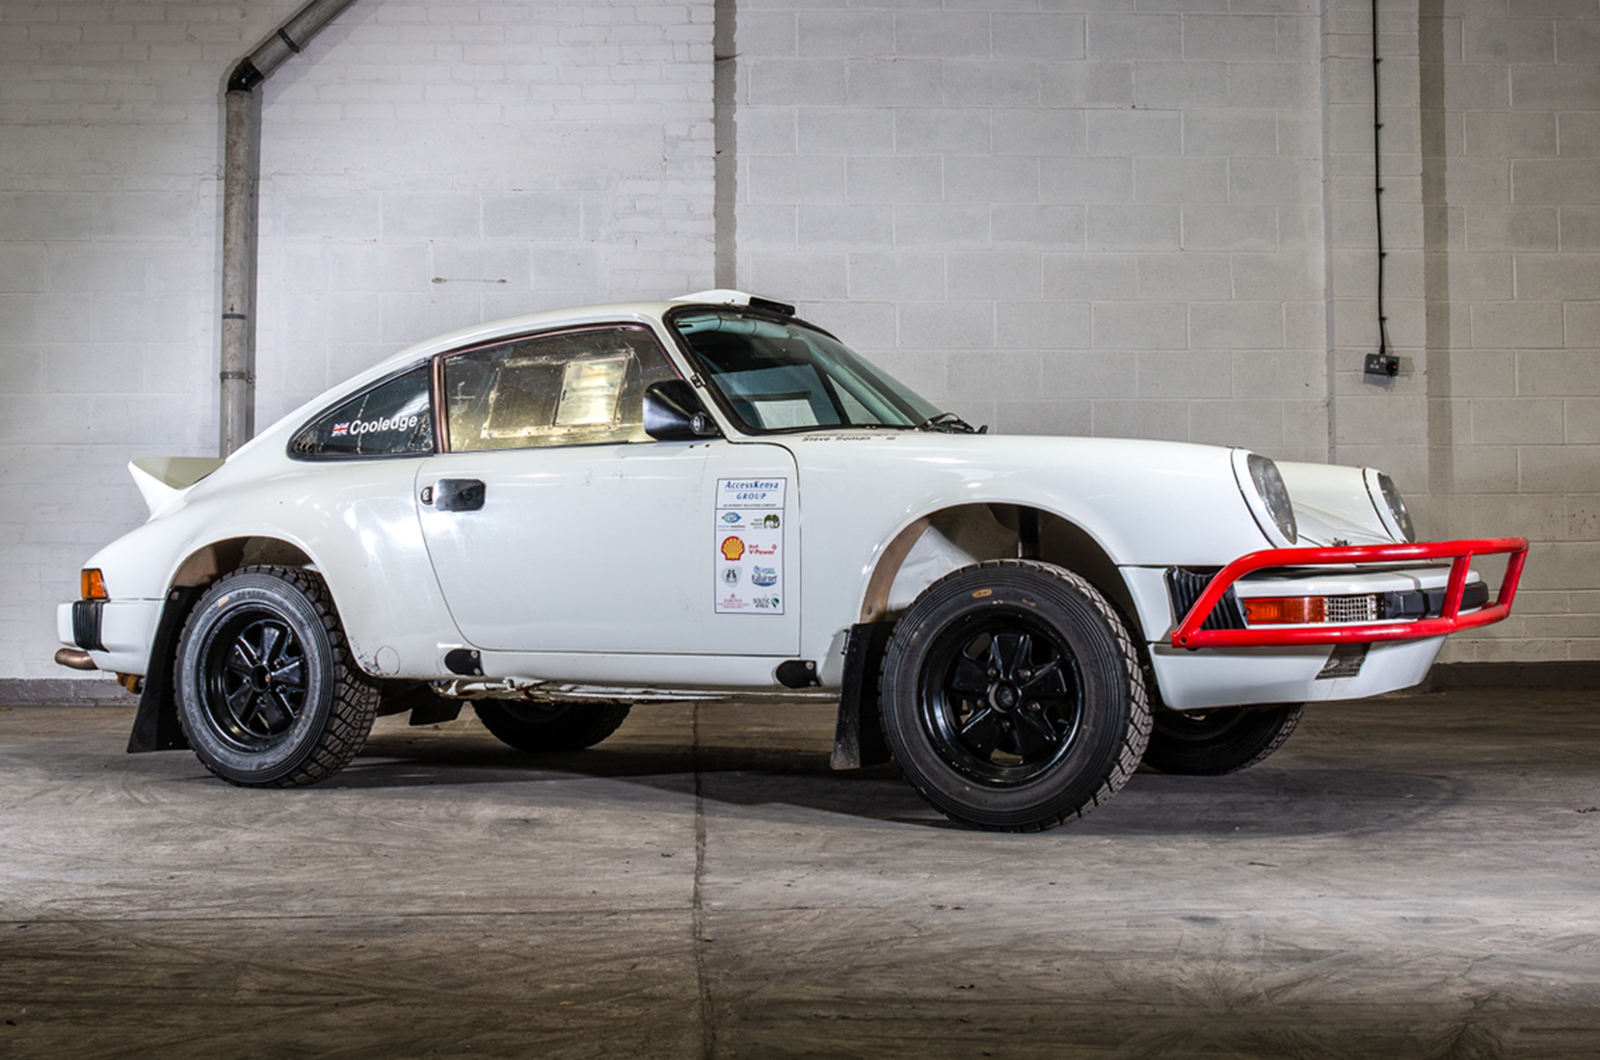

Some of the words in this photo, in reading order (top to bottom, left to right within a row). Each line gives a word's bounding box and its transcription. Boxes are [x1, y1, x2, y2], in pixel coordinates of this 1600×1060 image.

[349, 416, 418, 435] Cooledge
[724, 480, 780, 490] AccessKenya
[736, 492, 767, 500] GROUP
